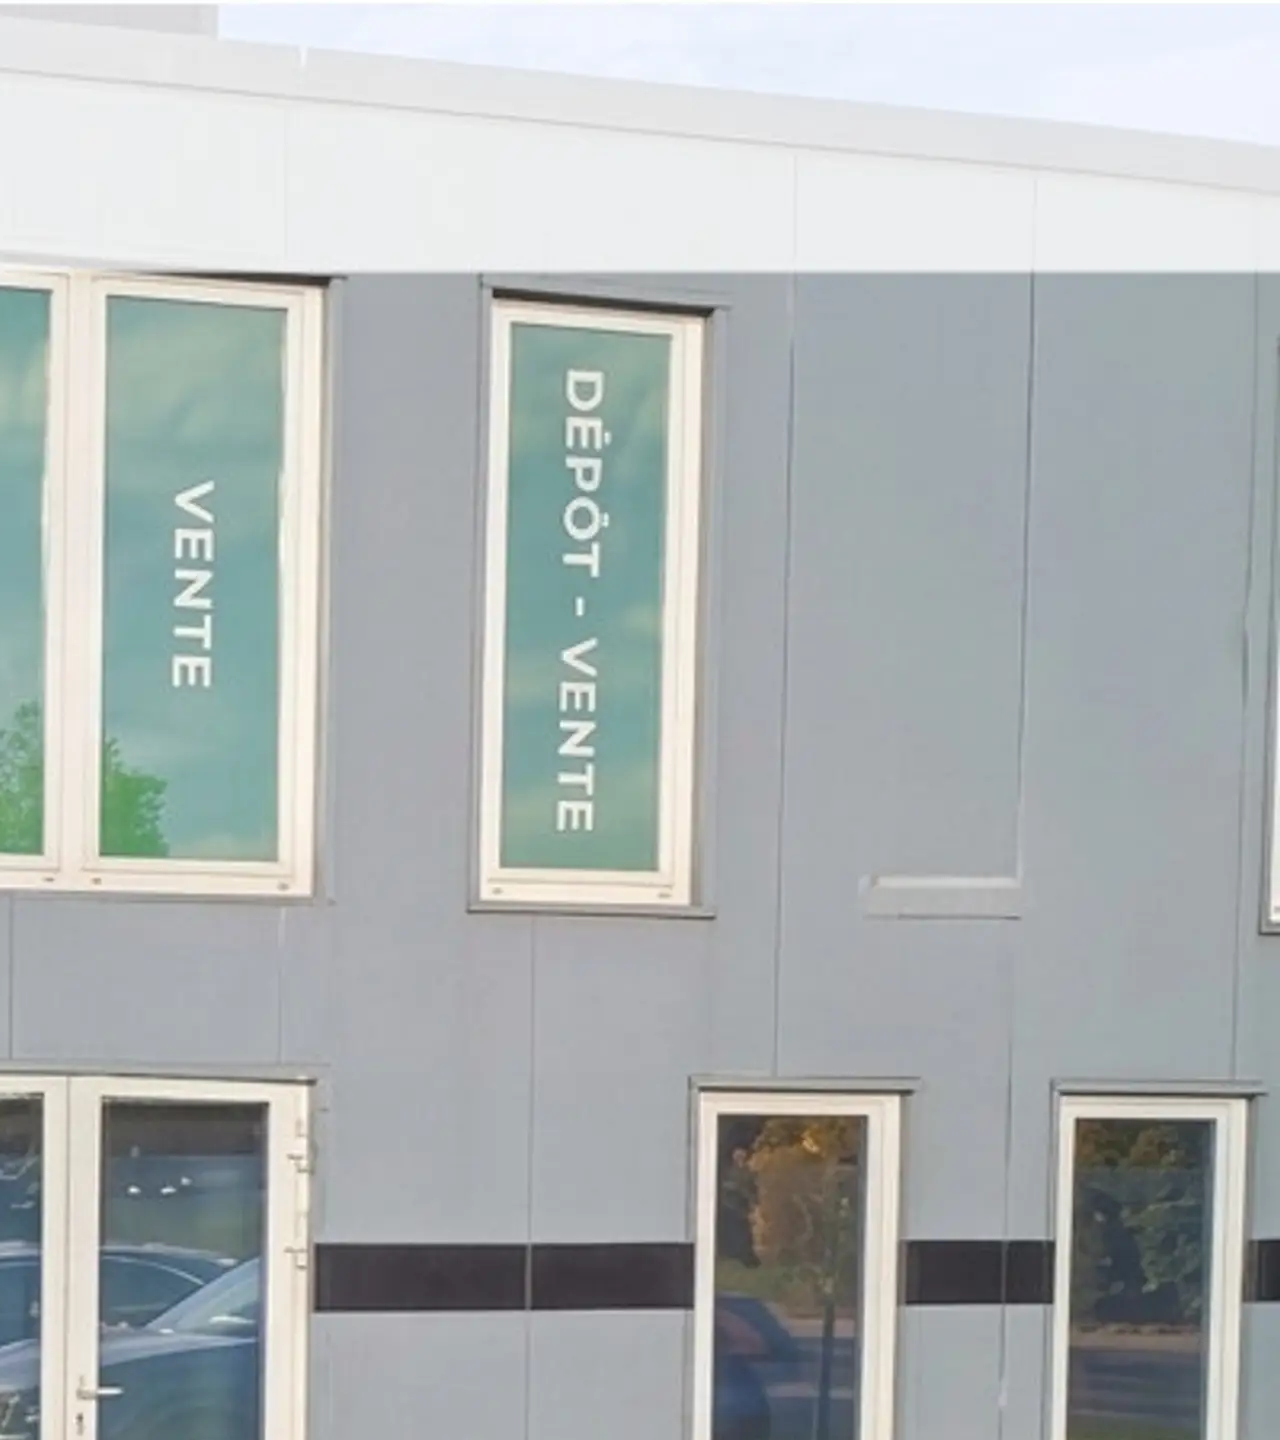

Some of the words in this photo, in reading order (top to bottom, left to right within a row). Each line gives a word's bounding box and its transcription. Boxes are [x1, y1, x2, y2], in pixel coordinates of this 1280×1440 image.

[562, 368, 612, 578] DÉPÔT
[171, 479, 215, 688] VENTE
[556, 637, 598, 832] VENTE
